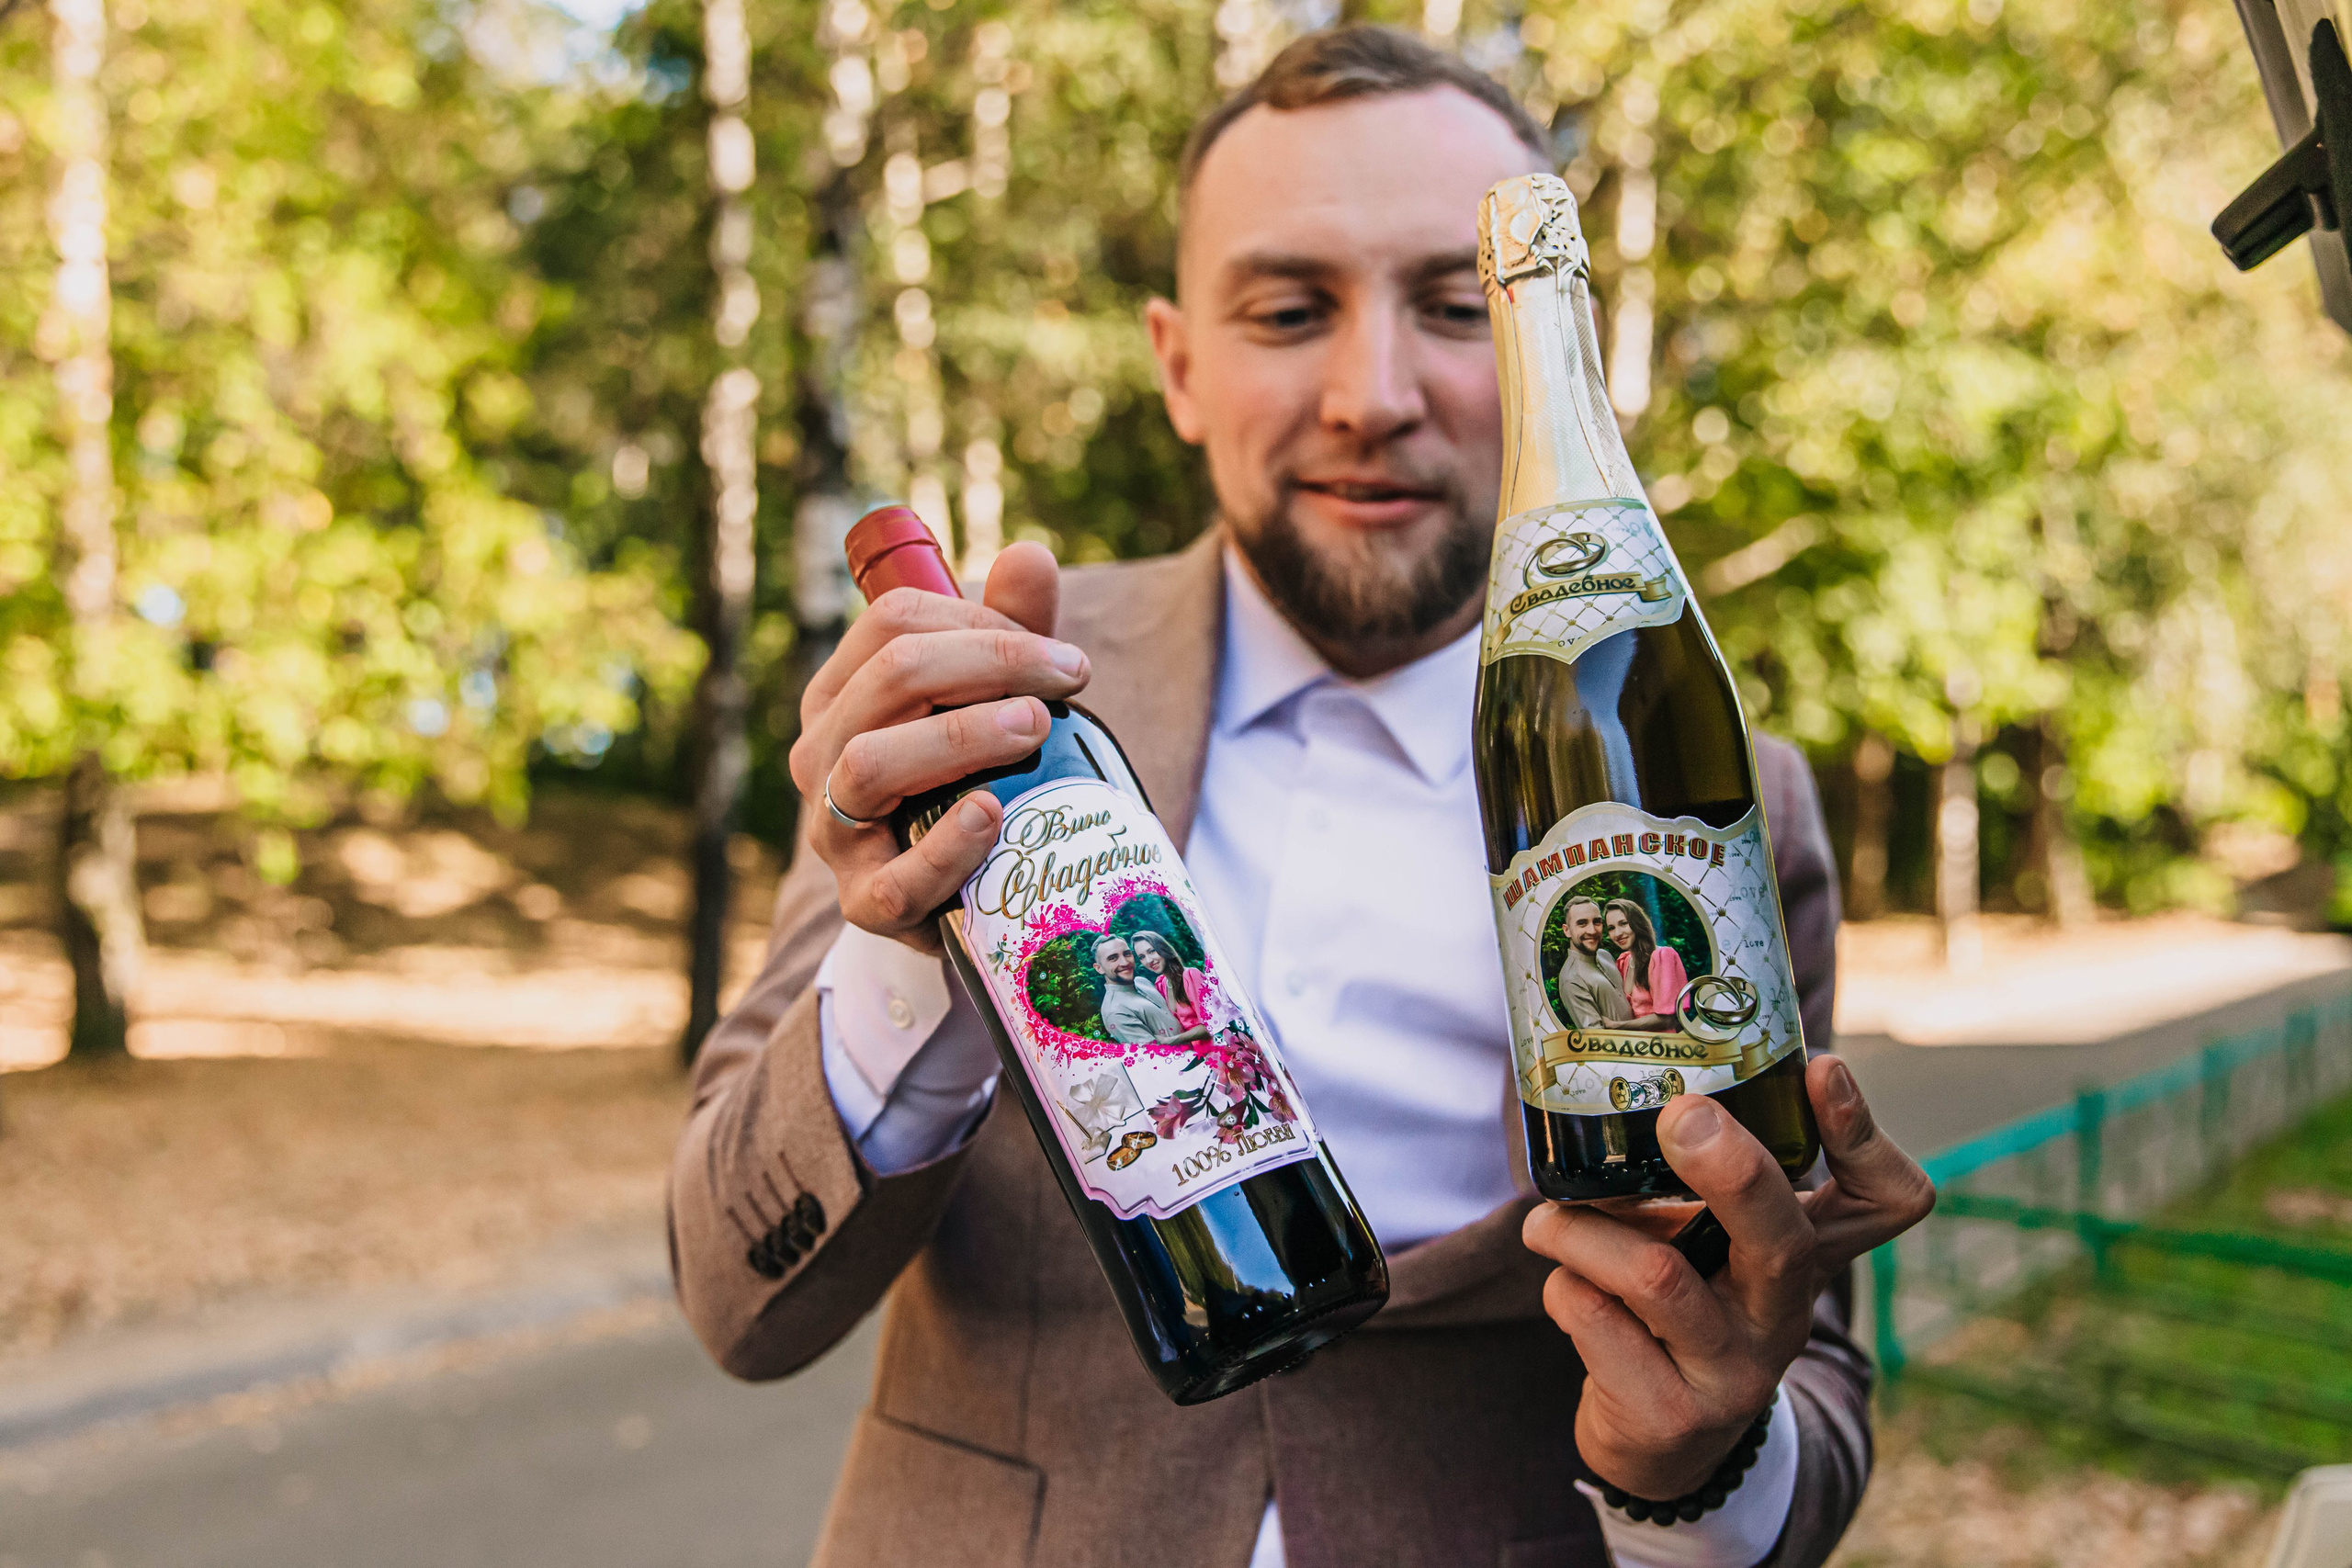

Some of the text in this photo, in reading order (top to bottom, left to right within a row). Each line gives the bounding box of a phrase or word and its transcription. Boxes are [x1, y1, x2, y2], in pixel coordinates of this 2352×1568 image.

[1510, 575, 1636, 615] Свадебное
[1003, 805, 1112, 855] Вино
[1503, 832, 1726, 910] ШАМПАНСКОЕ
[1744, 939, 1765, 949] love
[1567, 1030, 1710, 1059] Свадебное
[1171, 1141, 1232, 1187] 100%
